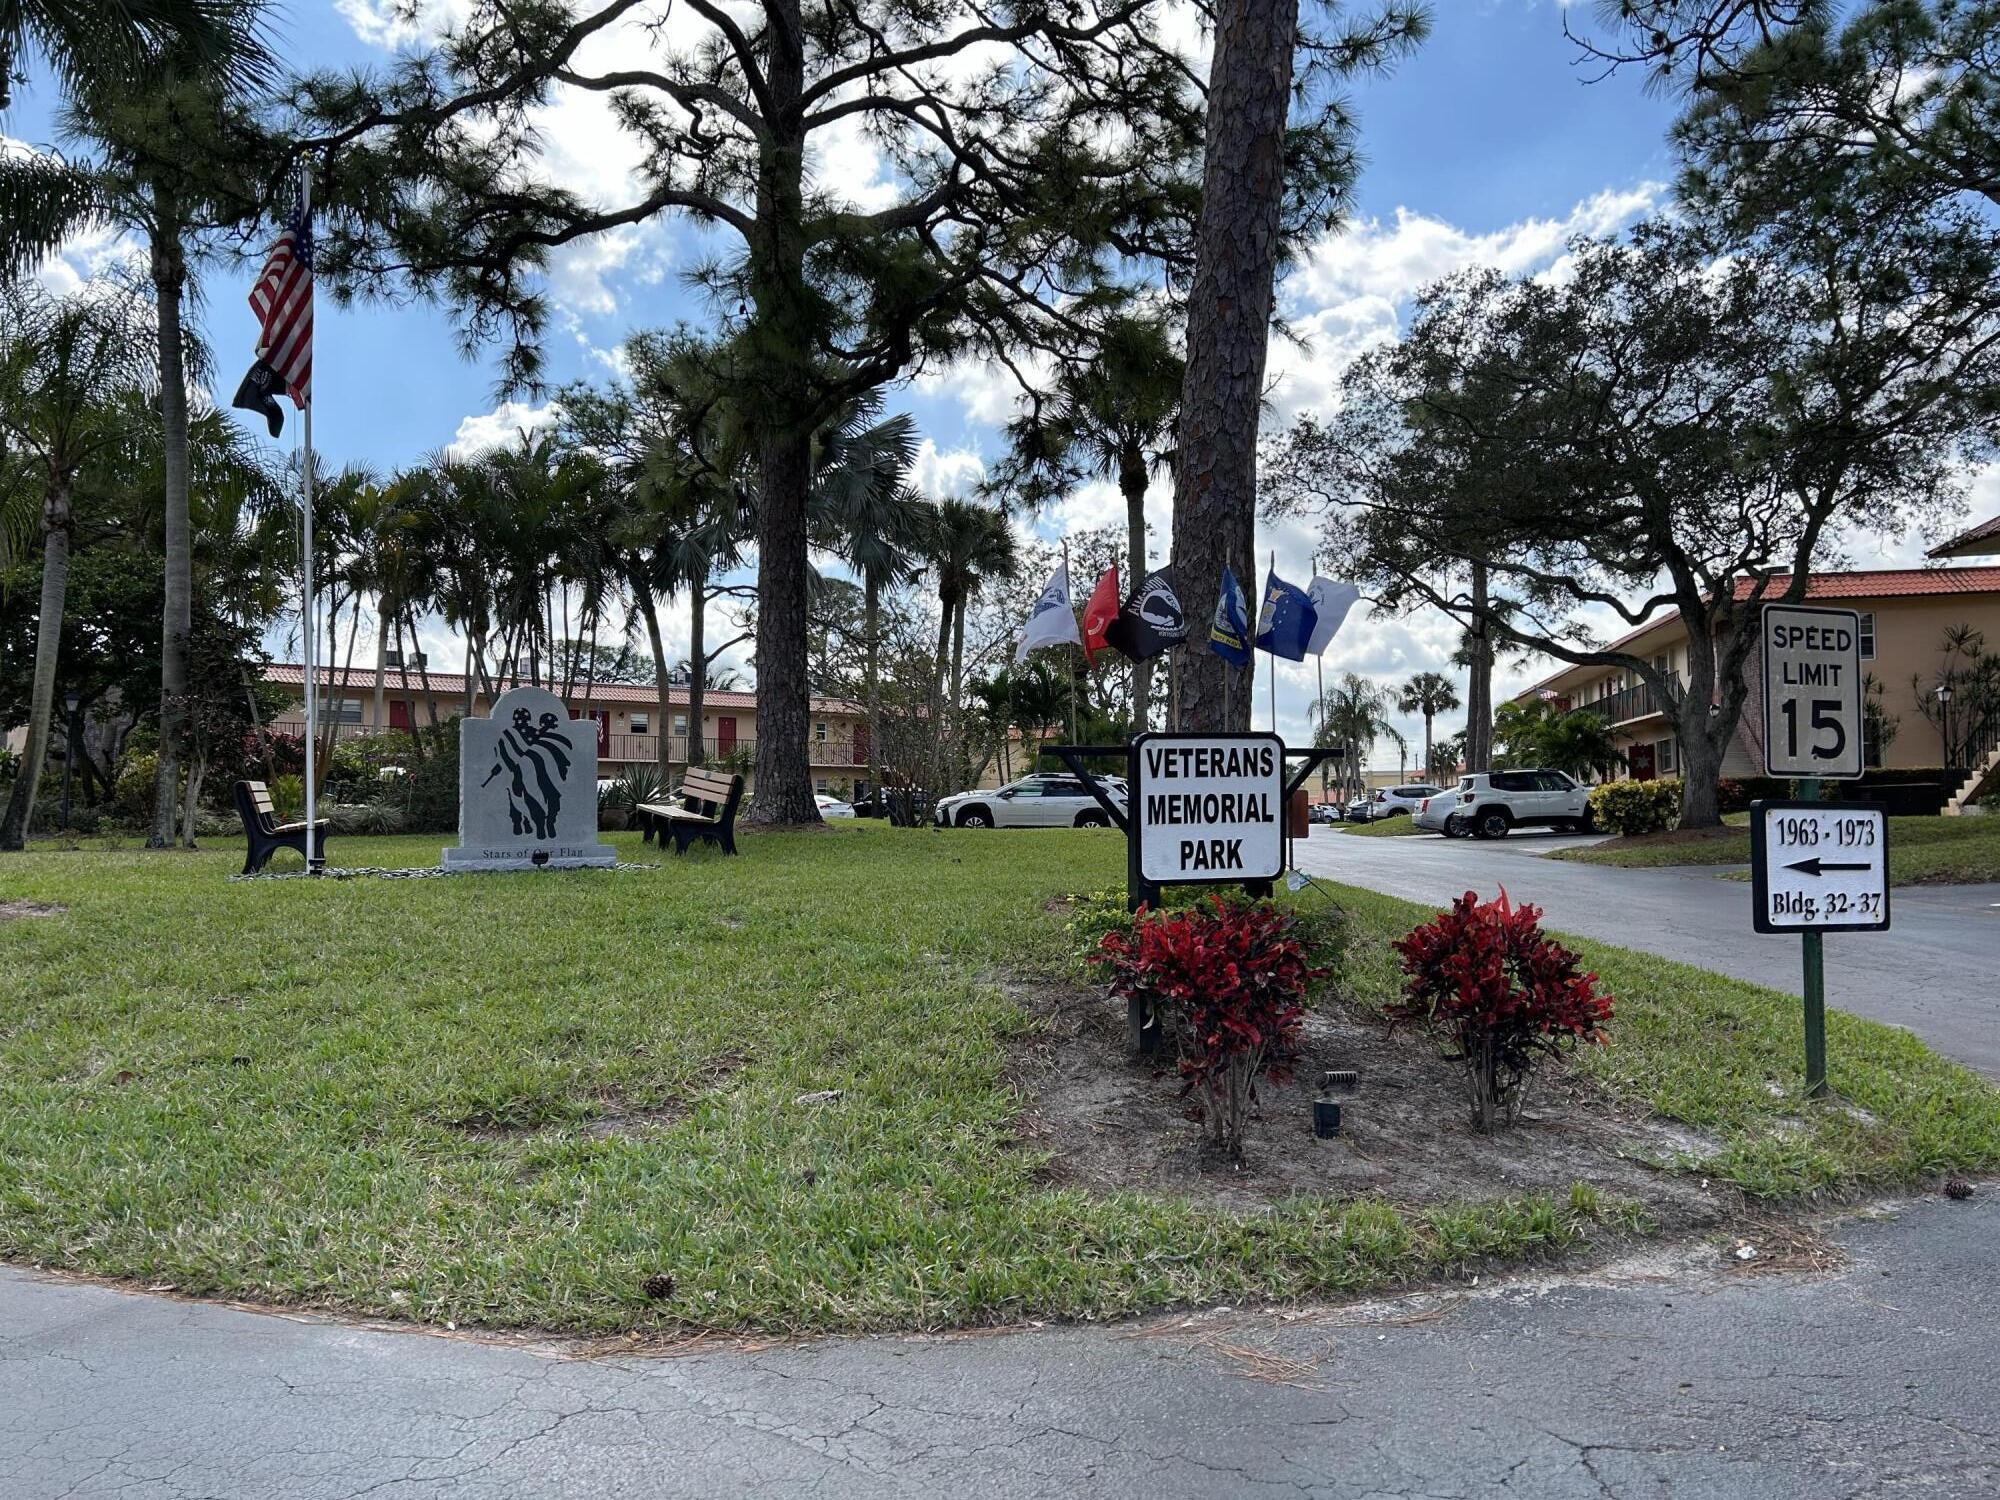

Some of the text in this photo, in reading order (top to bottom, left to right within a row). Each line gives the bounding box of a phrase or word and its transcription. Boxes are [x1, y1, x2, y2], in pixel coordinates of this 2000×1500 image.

[1773, 625, 1852, 652] SPEED
[1783, 661, 1843, 687] LIMIT
[1782, 698, 1846, 760] 15
[1146, 746, 1274, 779] VETERANS
[1147, 793, 1274, 825] MEMORIAL
[1777, 817, 1819, 845] 1963
[1836, 818, 1875, 845] 1973
[483, 849, 512, 859] Stars
[517, 848, 529, 858] of
[560, 848, 583, 858] Flag
[1180, 838, 1243, 871] PARK
[1773, 890, 1820, 922] Bldg.
